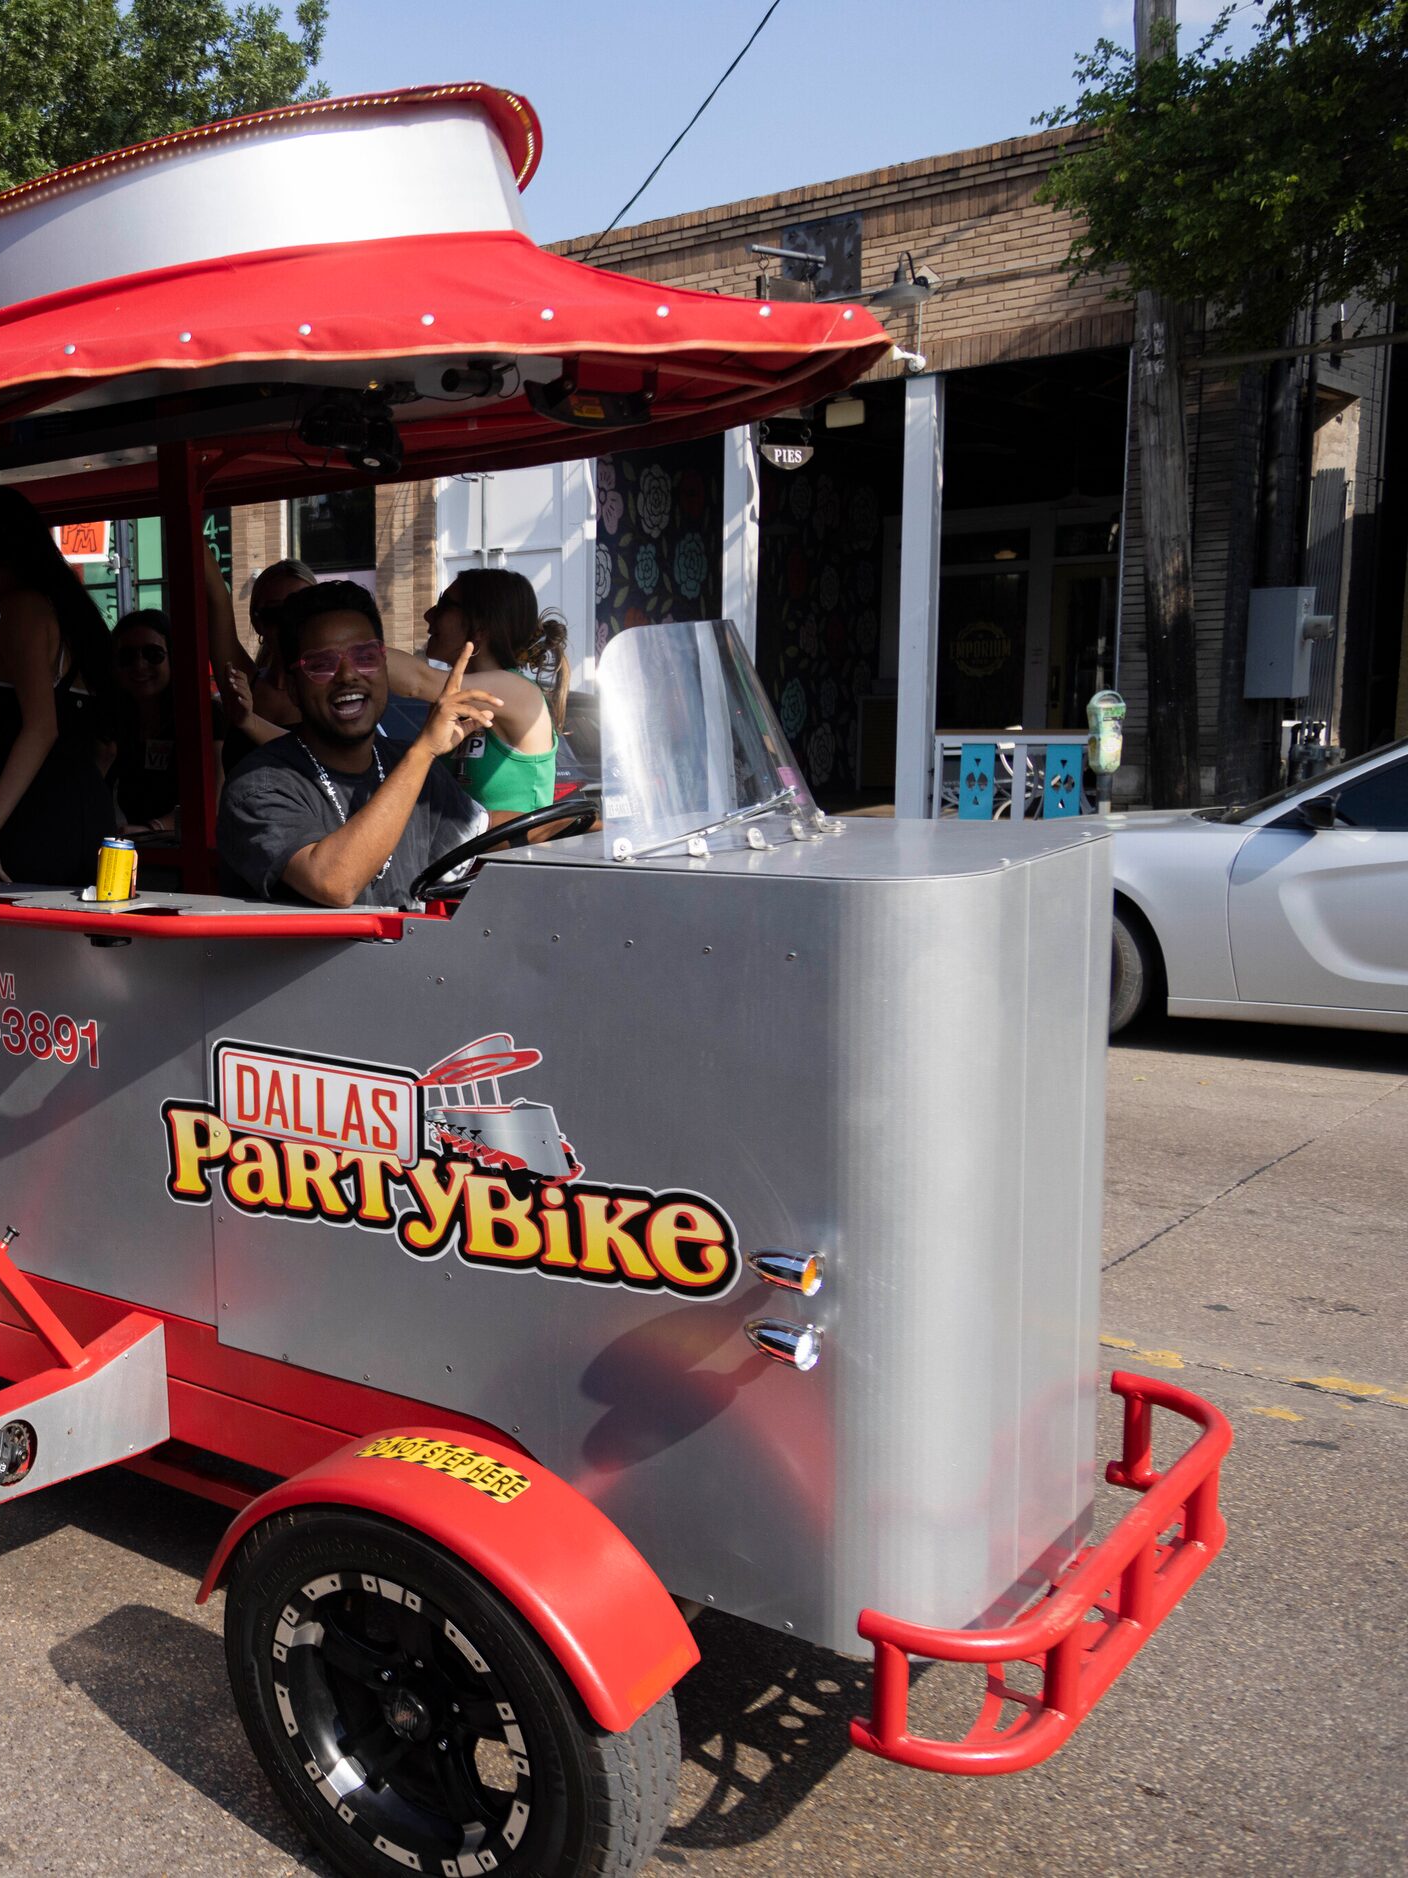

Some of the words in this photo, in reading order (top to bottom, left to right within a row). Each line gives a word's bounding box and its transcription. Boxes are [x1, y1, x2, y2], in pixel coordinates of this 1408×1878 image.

[774, 448, 803, 463] PIES
[949, 640, 1012, 659] EMPORIUM
[235, 1063, 399, 1151] DALLAS
[360, 1440, 390, 1454] DO
[386, 1441, 426, 1456] NOT
[422, 1446, 475, 1470] STEP
[468, 1463, 526, 1500] HERE
